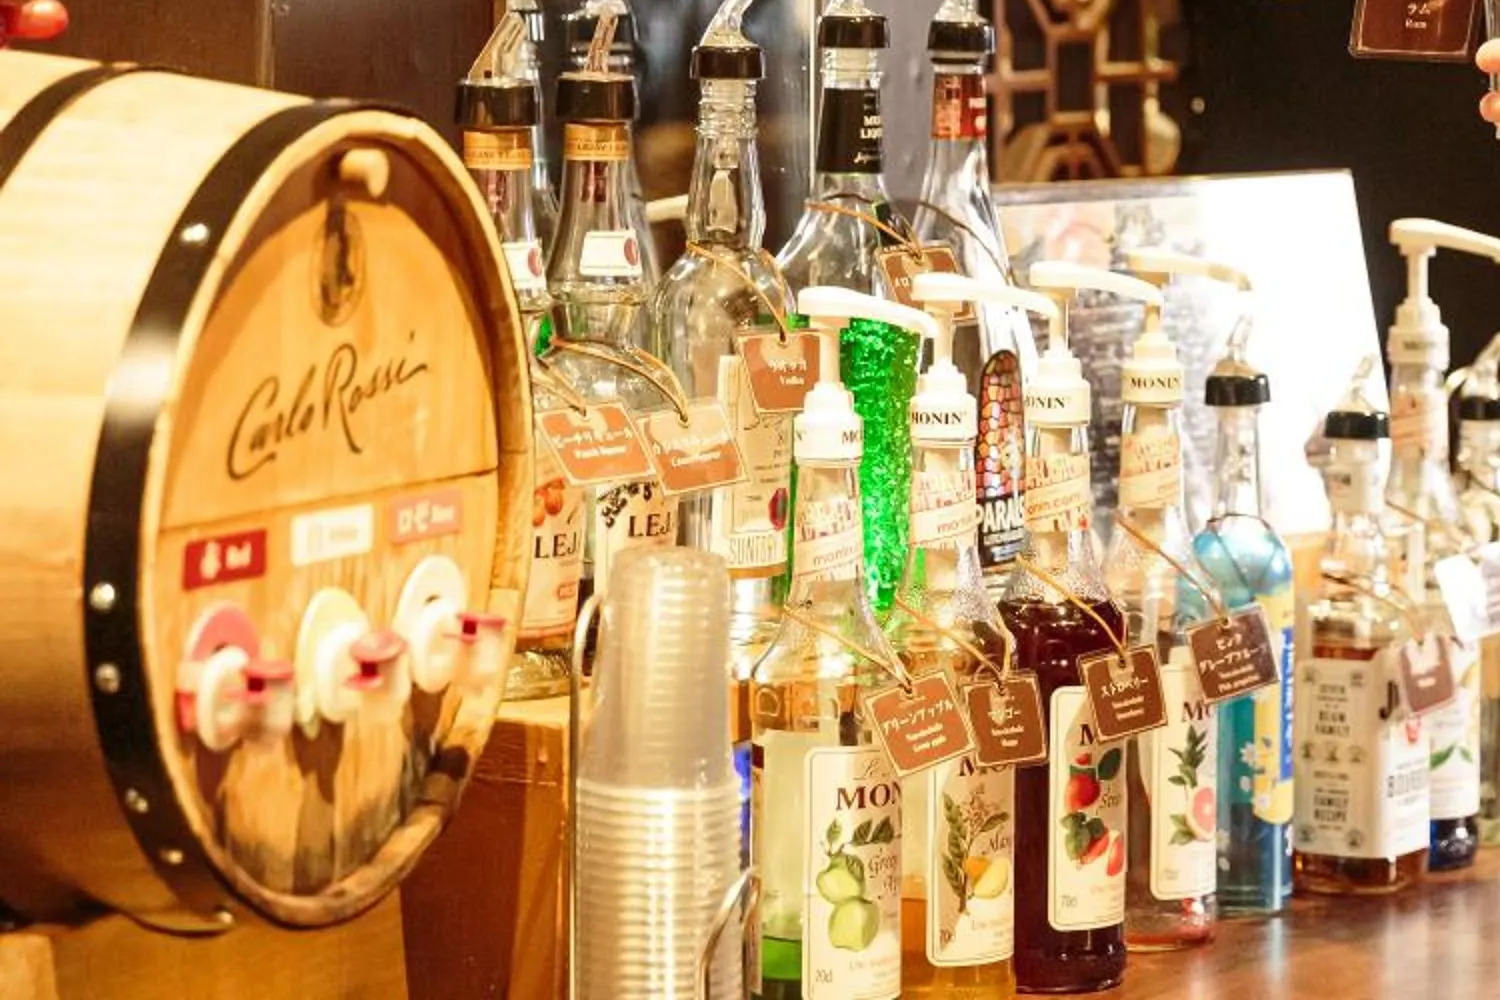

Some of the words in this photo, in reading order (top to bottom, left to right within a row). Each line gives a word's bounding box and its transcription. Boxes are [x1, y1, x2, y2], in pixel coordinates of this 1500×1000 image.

[226, 364, 316, 482] Carlo
[322, 330, 428, 455] Rossi
[1130, 376, 1181, 390] MONIN
